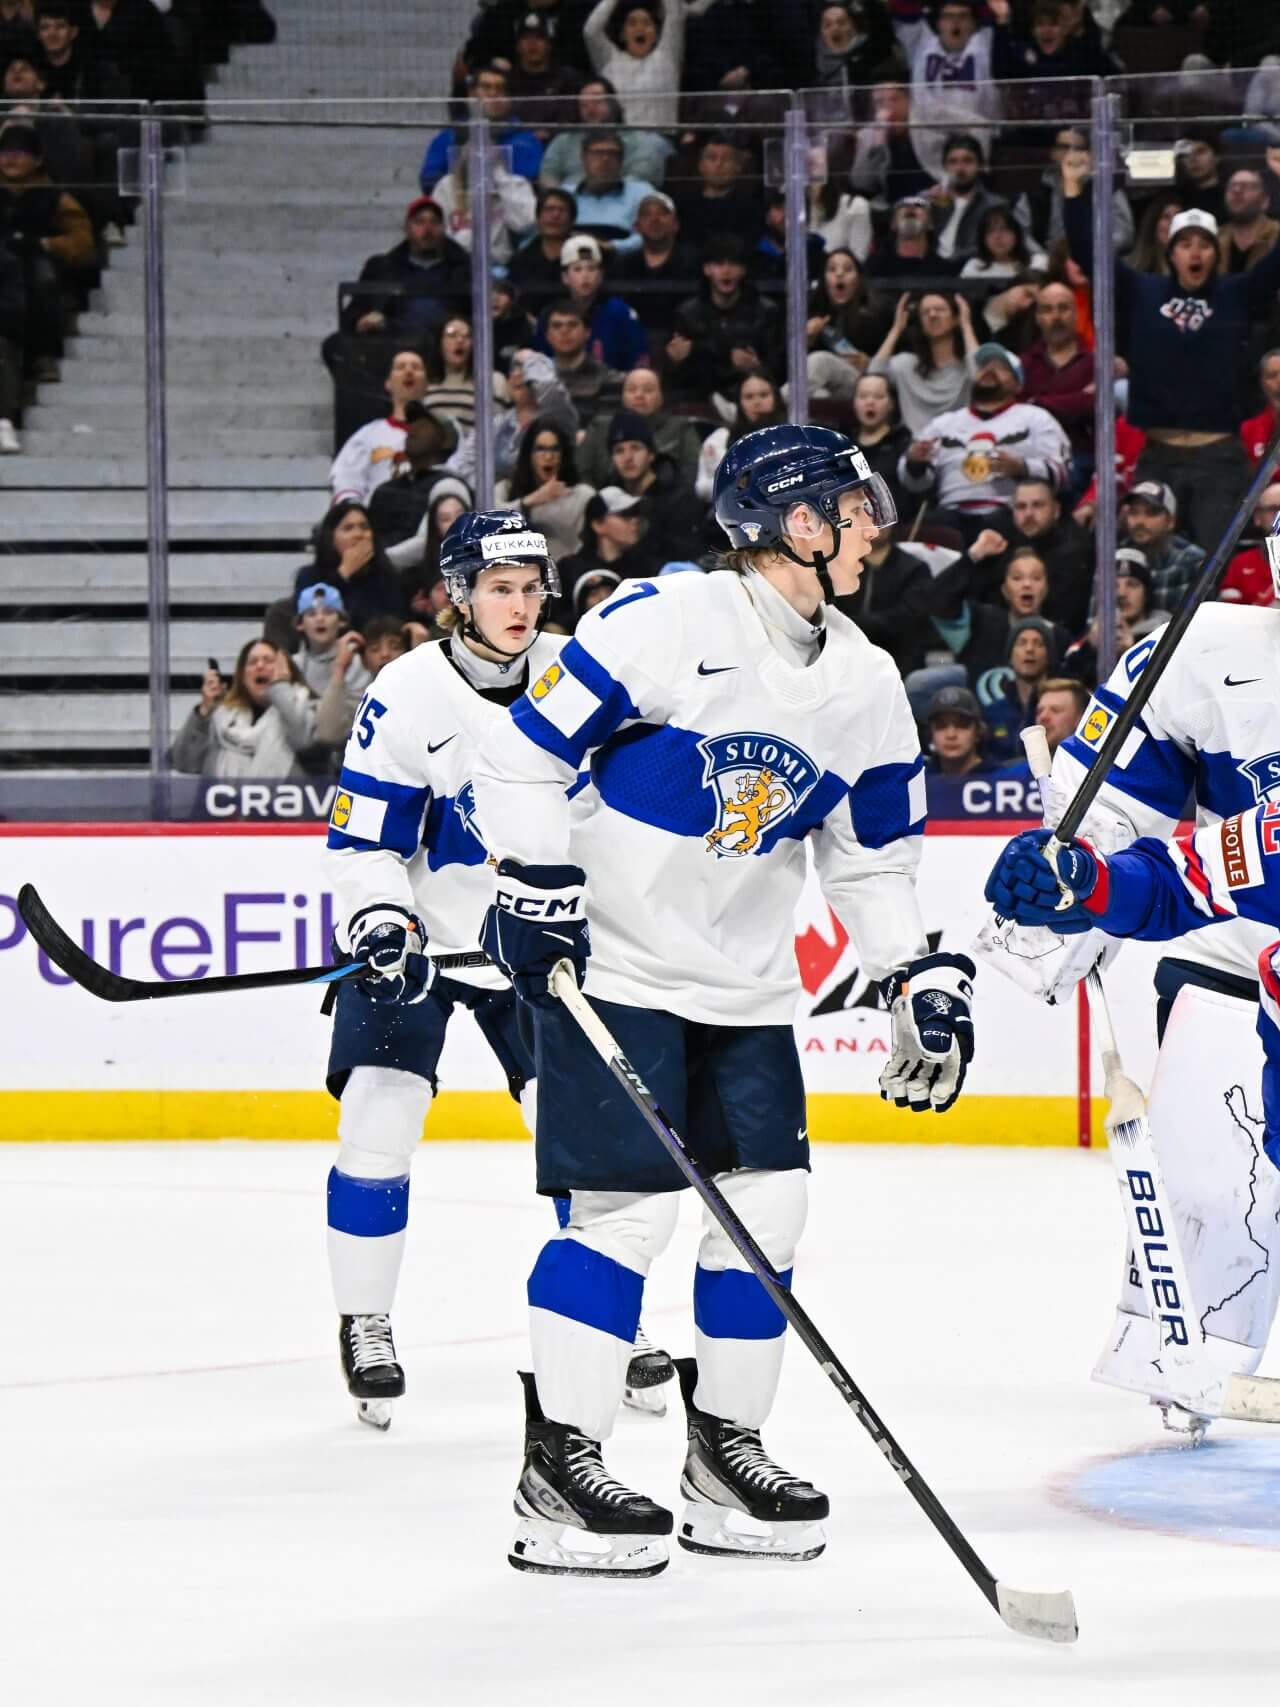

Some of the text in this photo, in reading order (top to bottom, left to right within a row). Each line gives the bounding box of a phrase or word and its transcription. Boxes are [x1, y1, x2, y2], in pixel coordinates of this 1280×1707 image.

[767, 474, 804, 493] CCM
[484, 540, 545, 552] VEIKKAUS
[599, 581, 661, 620] 7
[350, 692, 389, 750] 5
[726, 741, 808, 784] SUOMI
[497, 889, 581, 918] CCM
[886, 976, 896, 1004] CCM
[923, 1030, 950, 1038] CCM
